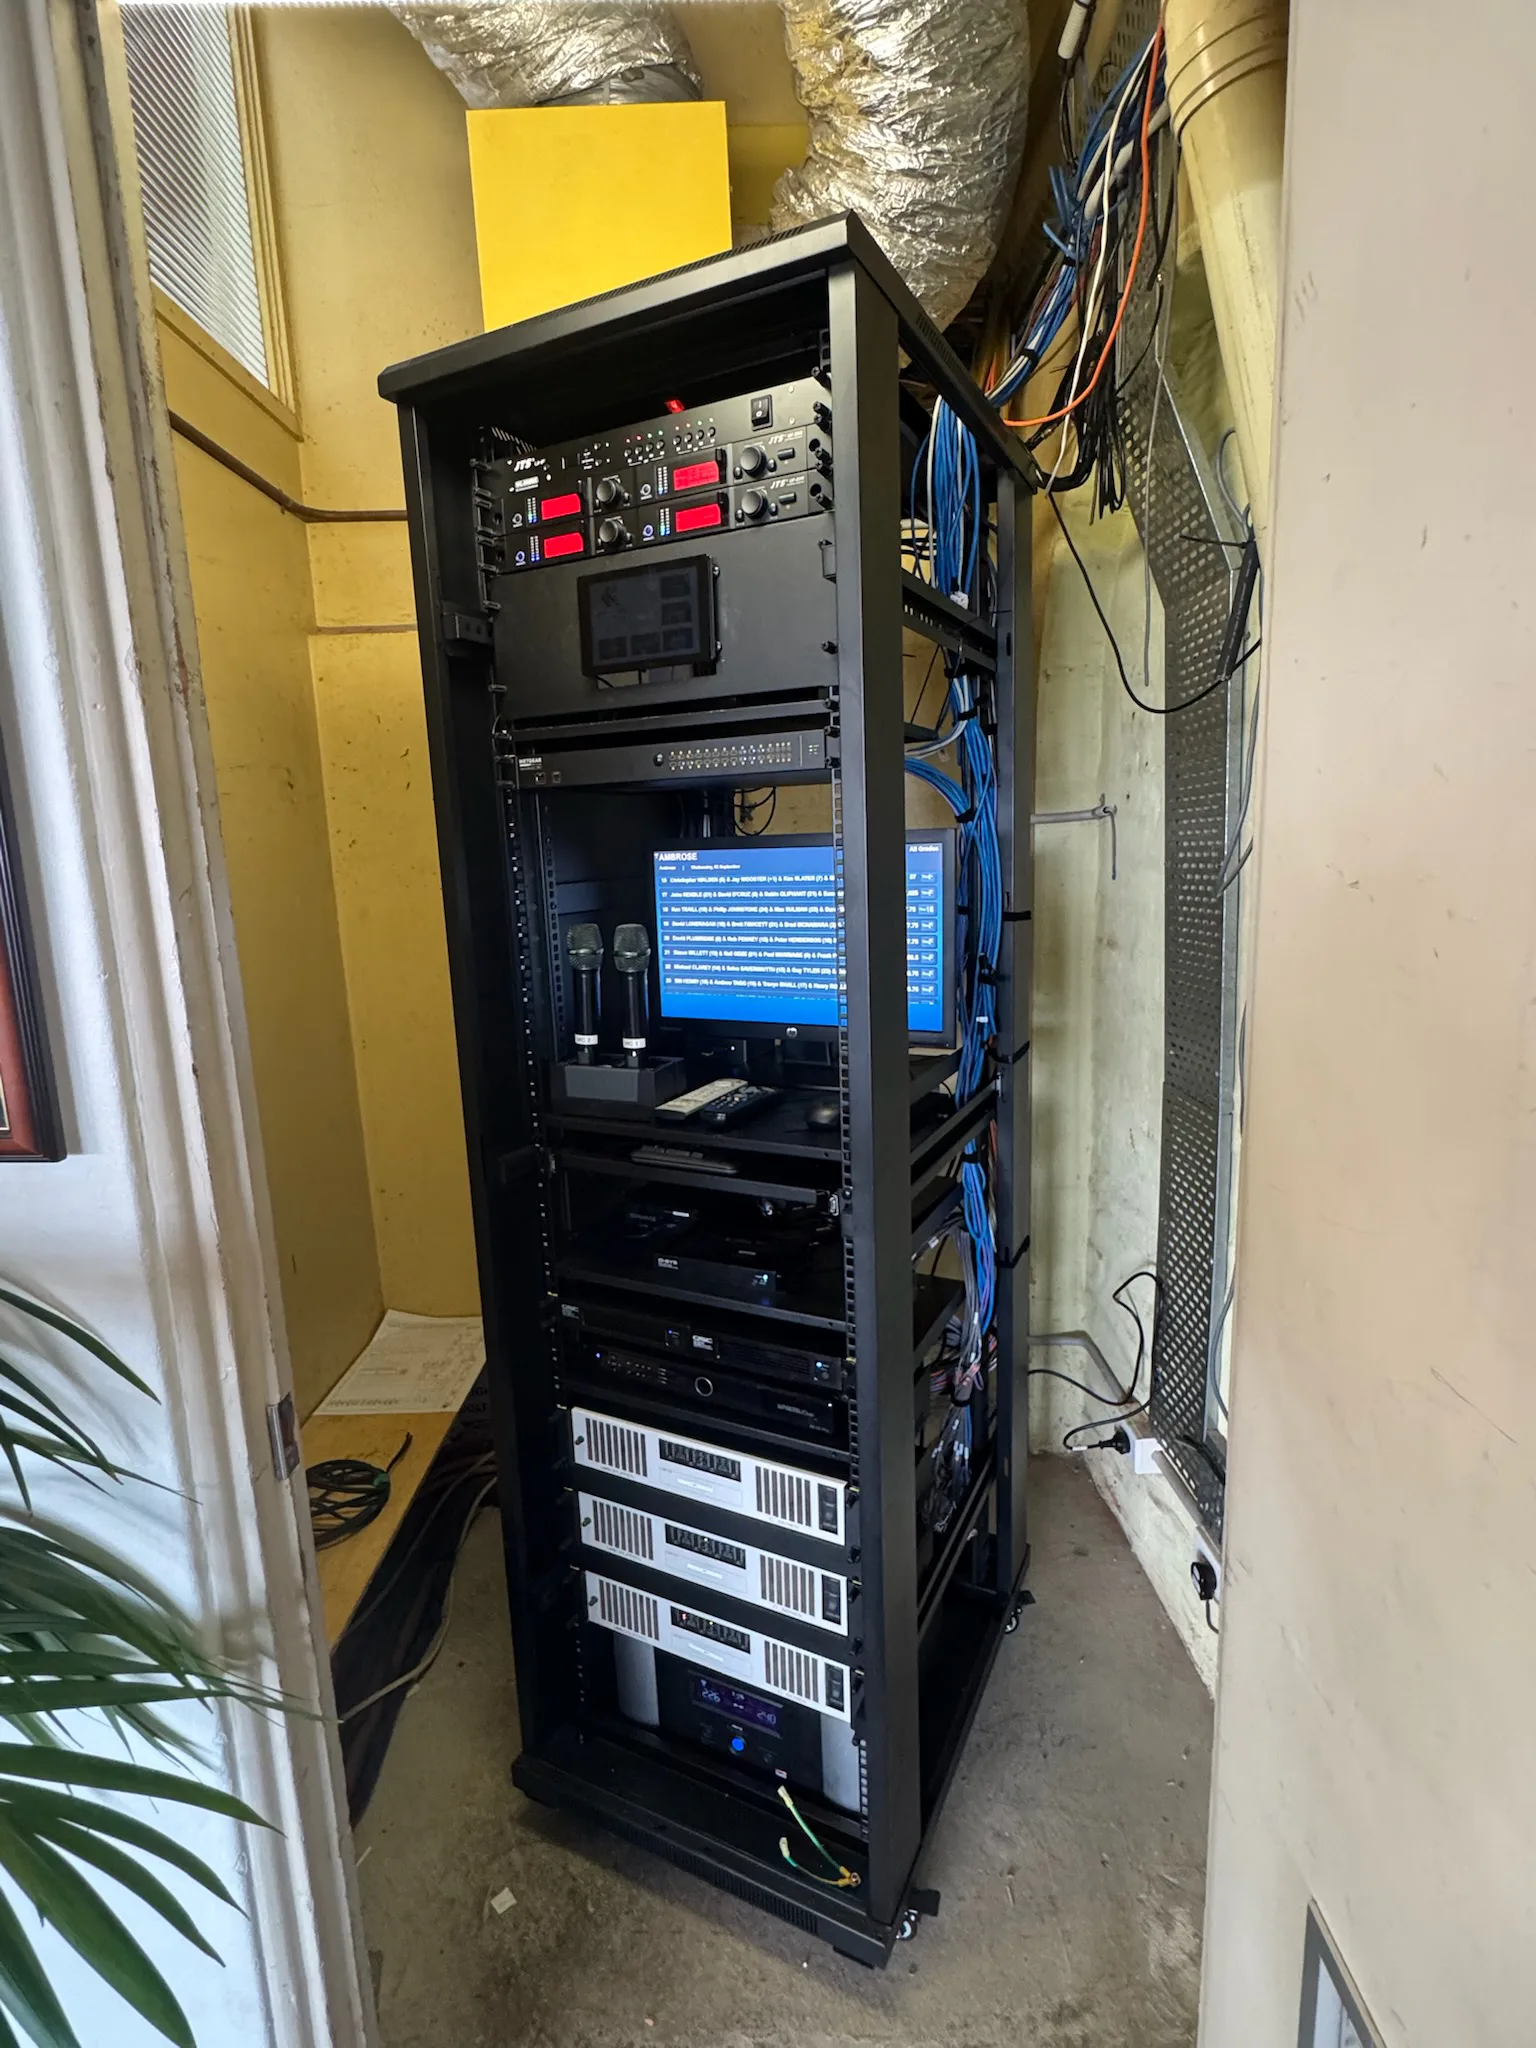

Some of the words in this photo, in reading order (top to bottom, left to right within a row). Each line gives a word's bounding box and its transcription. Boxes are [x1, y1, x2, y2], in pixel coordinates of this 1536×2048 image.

[768, 434, 784, 445] JTS
[513, 457, 532, 472] JTS
[770, 478, 786, 490] JTS
[658, 852, 698, 861] AMBROSE
